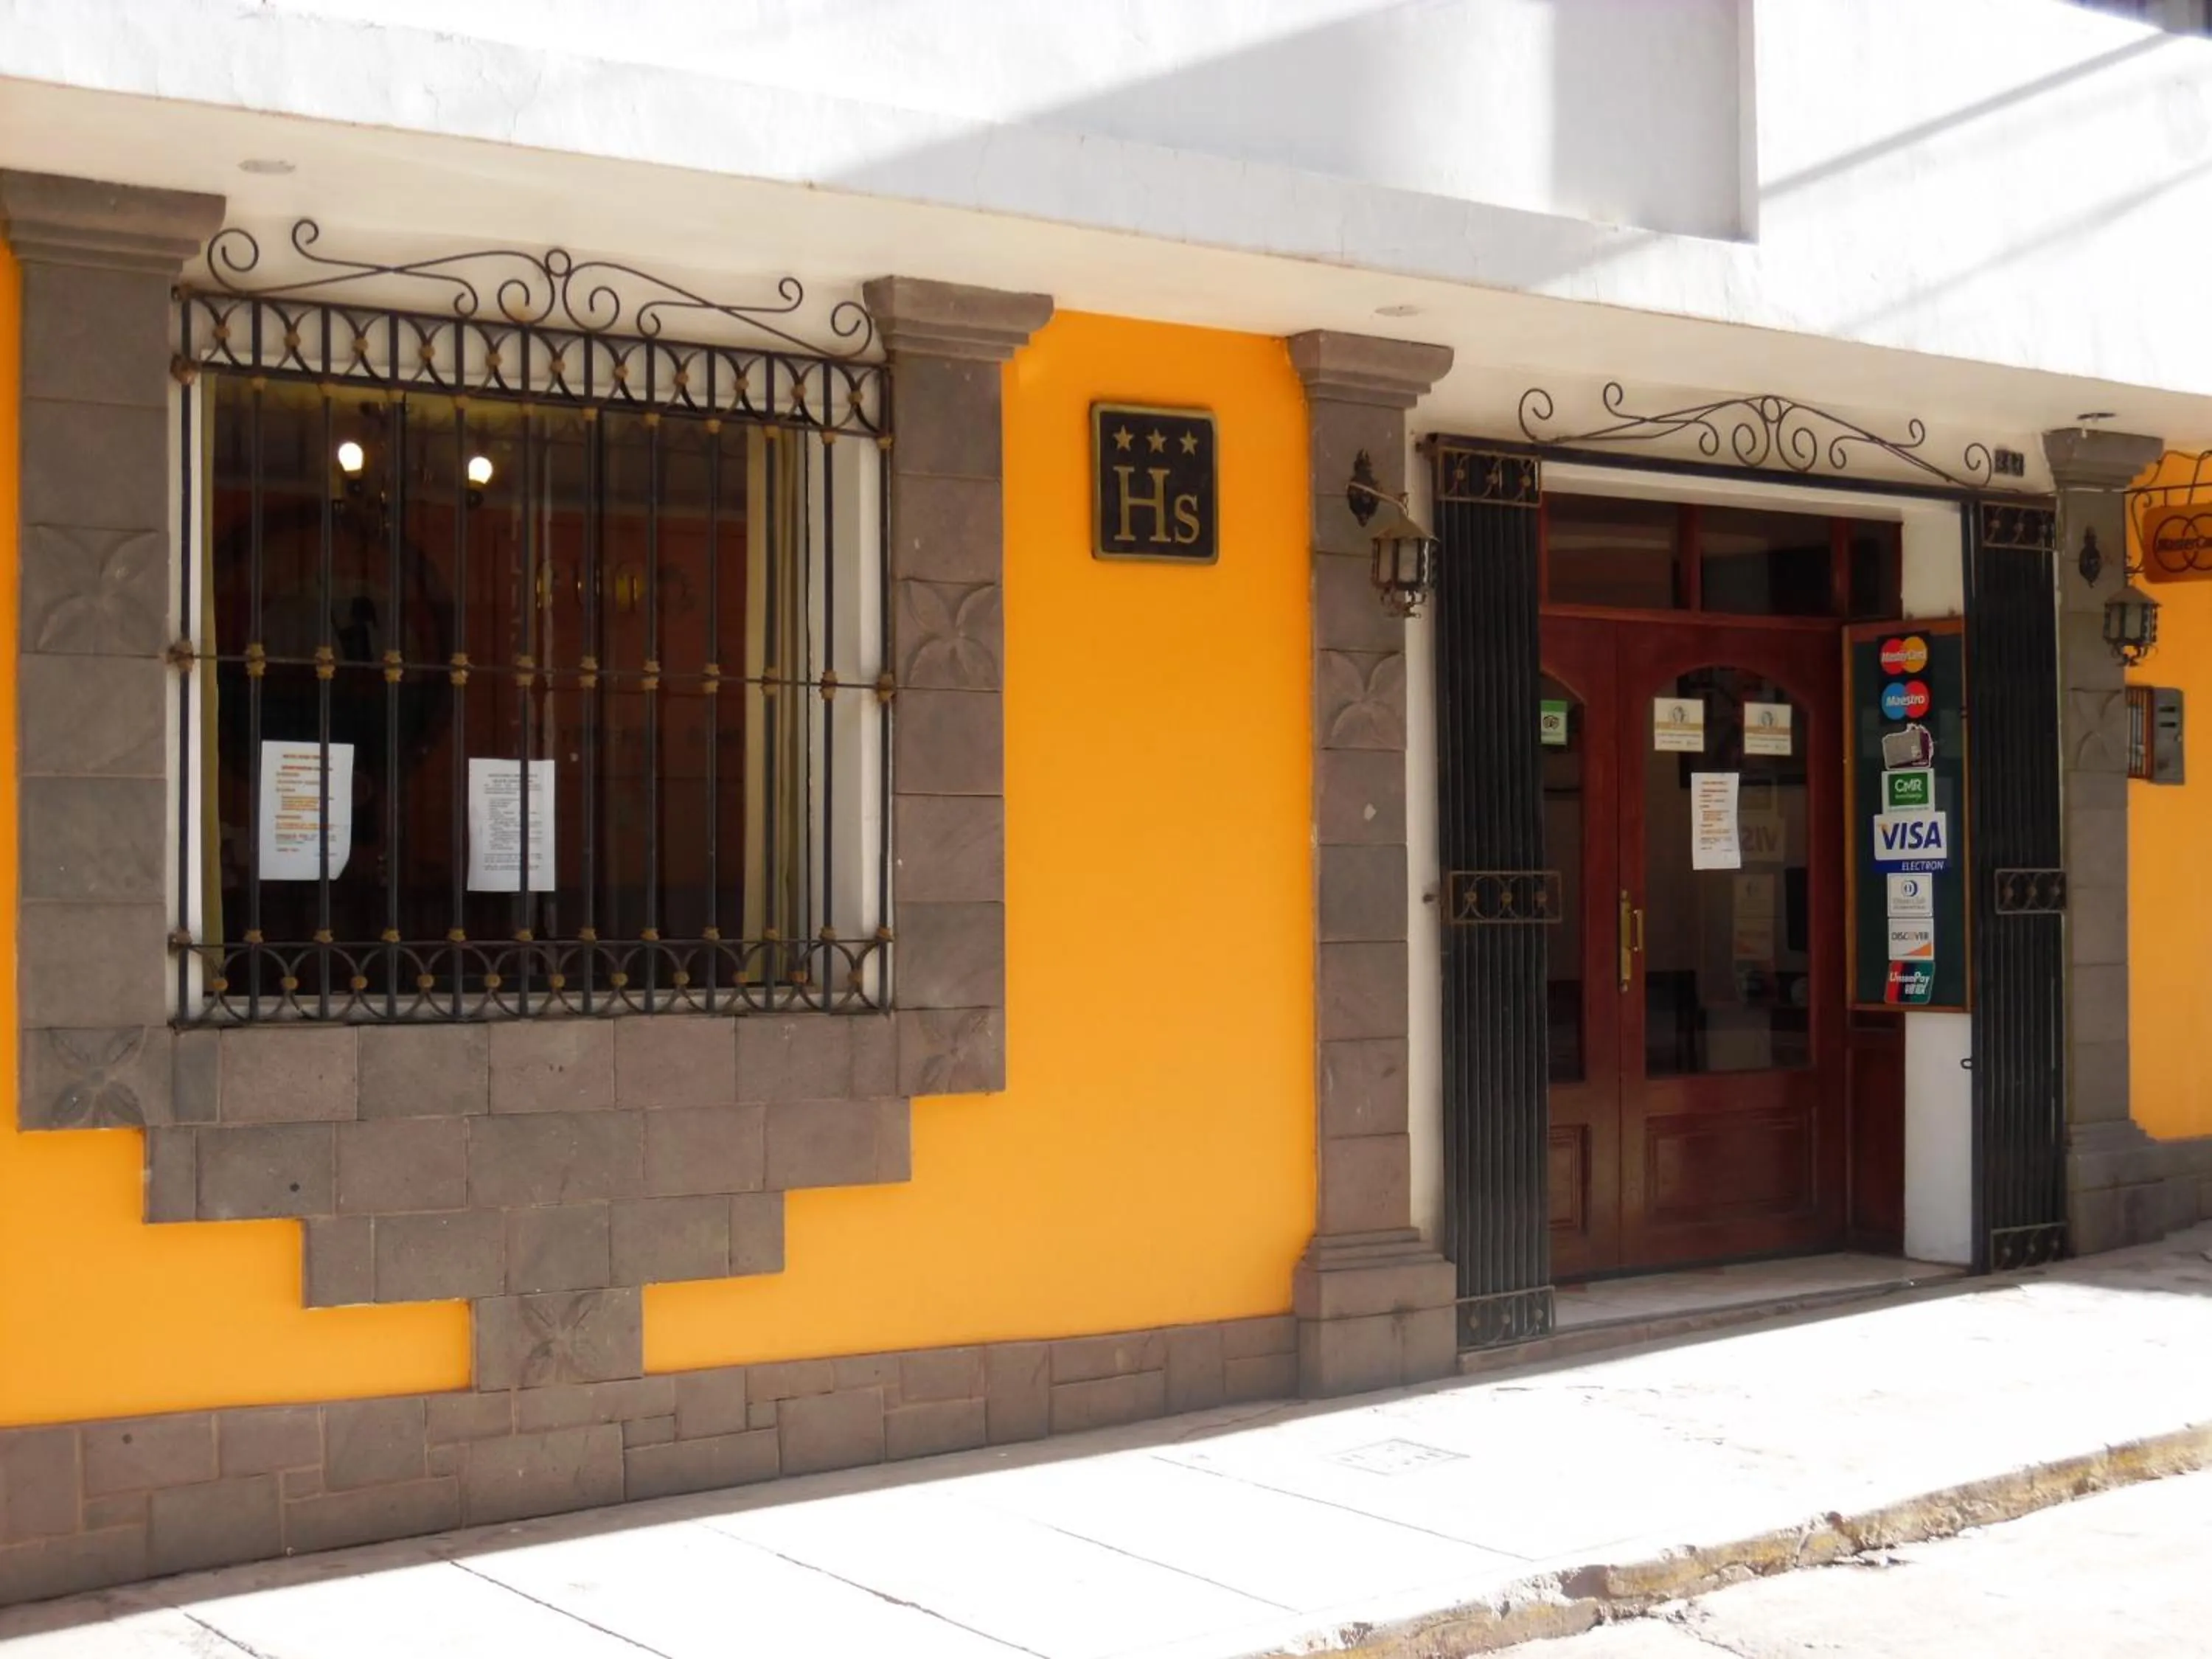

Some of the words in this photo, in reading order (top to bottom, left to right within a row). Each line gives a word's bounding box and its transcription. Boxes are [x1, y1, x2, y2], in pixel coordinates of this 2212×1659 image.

[1113, 465, 1200, 544] Hs
[1886, 694, 1926, 706] Maestro
[1894, 779, 1923, 792] CMR
[1878, 821, 1941, 850] VISA
[1902, 860, 1944, 871] ELECTRON
[1891, 931, 1929, 942] DISCOVER
